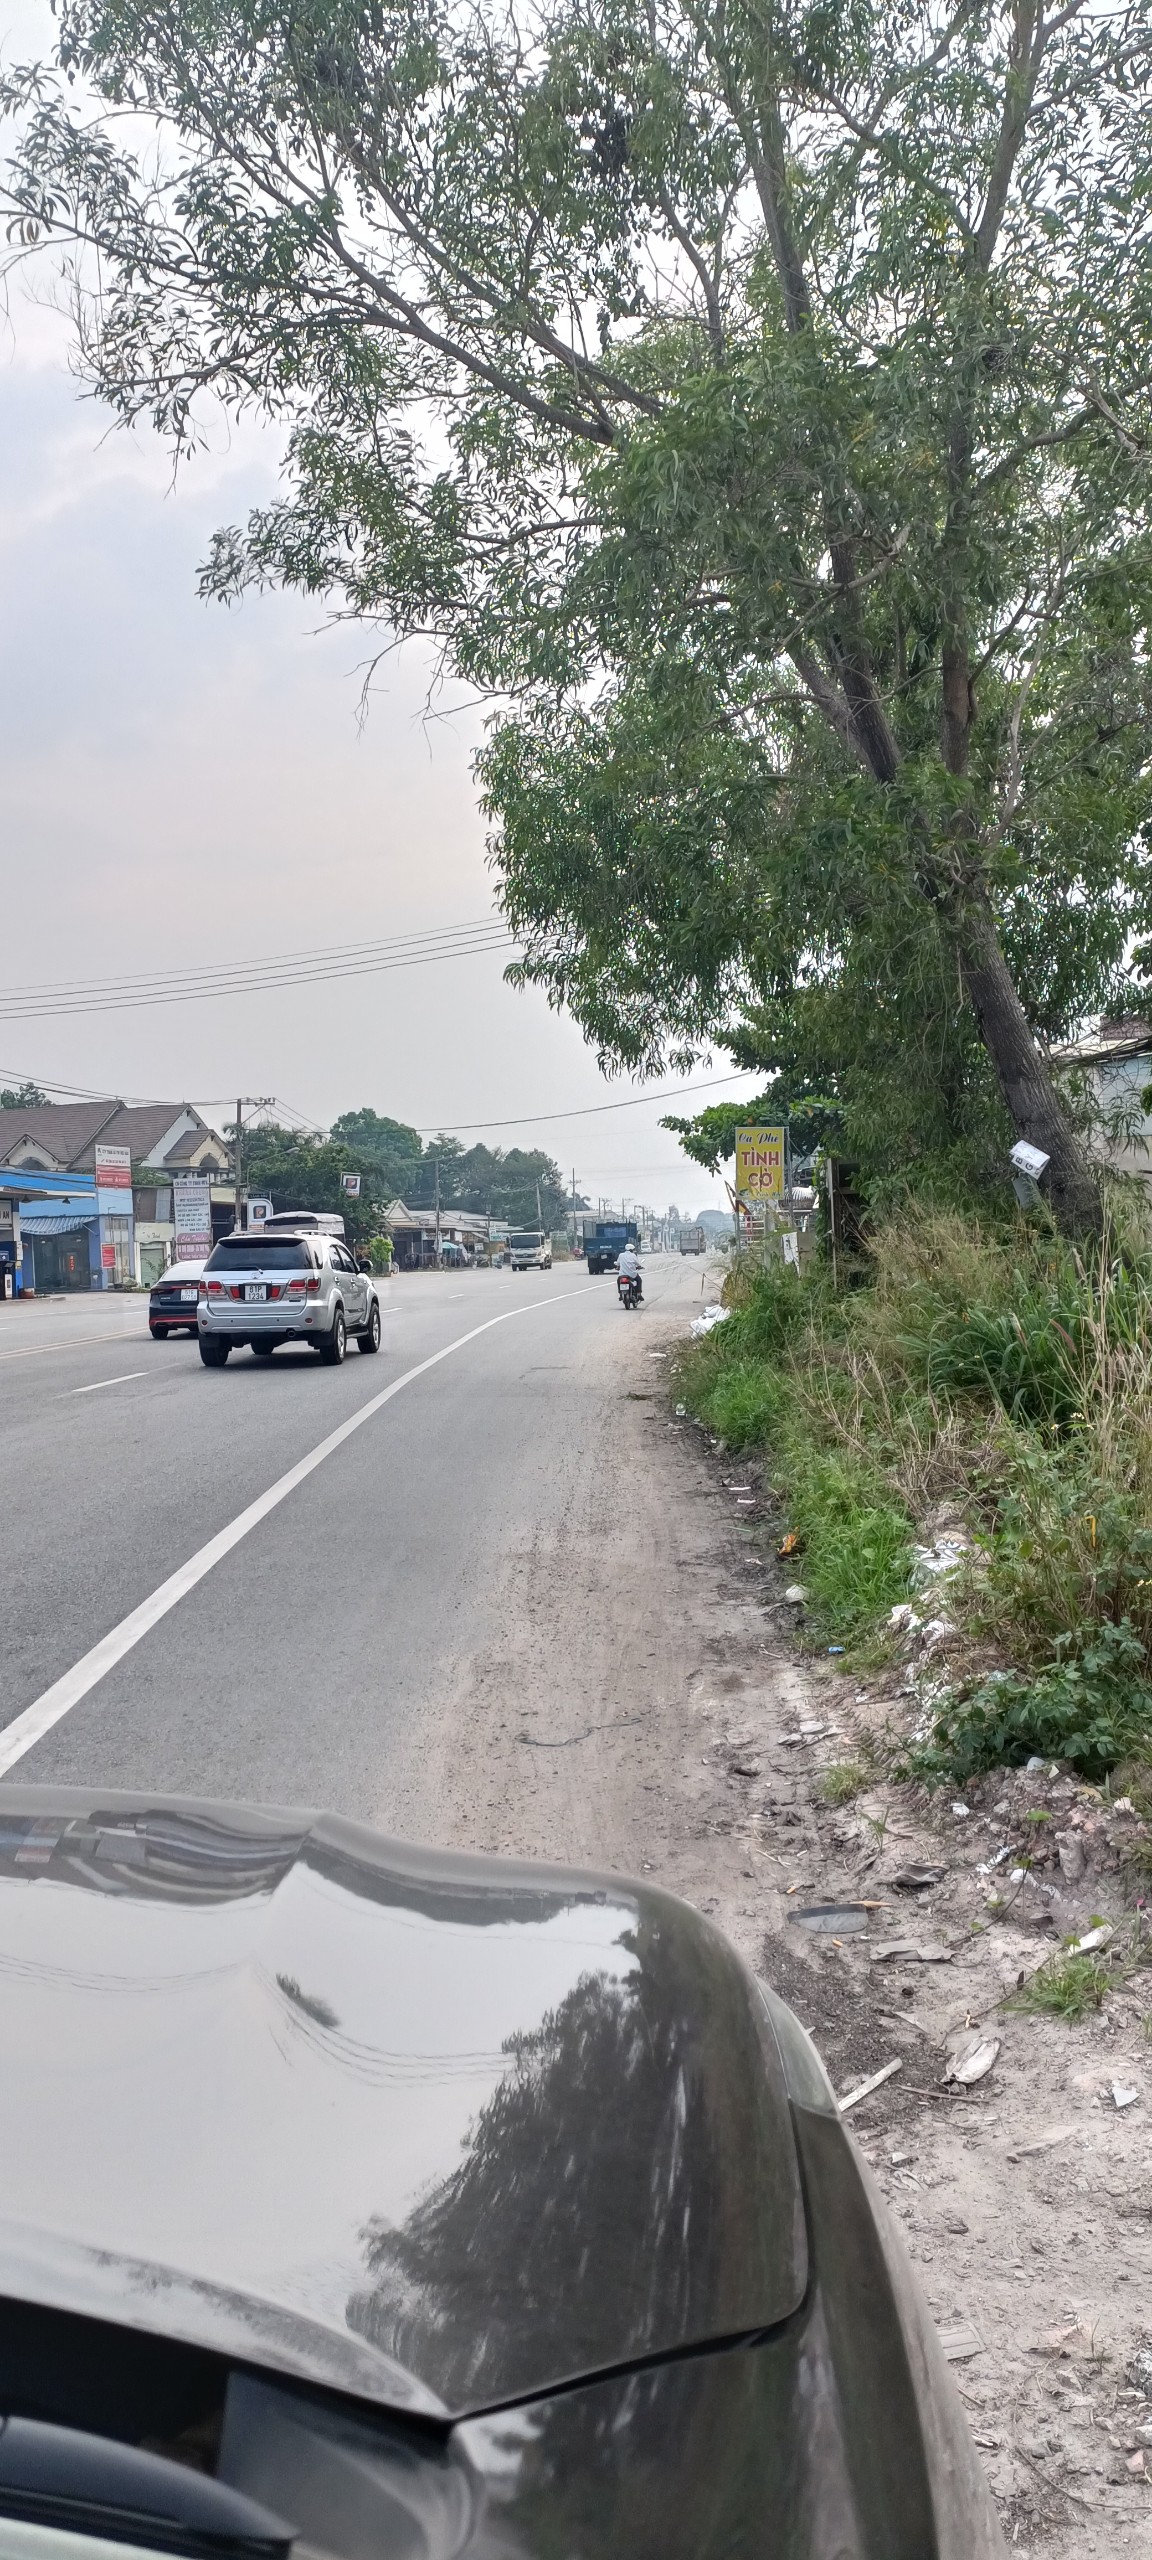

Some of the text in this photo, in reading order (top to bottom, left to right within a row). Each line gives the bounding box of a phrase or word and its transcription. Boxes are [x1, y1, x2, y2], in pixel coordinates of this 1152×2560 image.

[741, 1146, 780, 1166] TÌNH
[748, 1167, 773, 1187] CỜ
[248, 1292, 264, 1300] 1234
